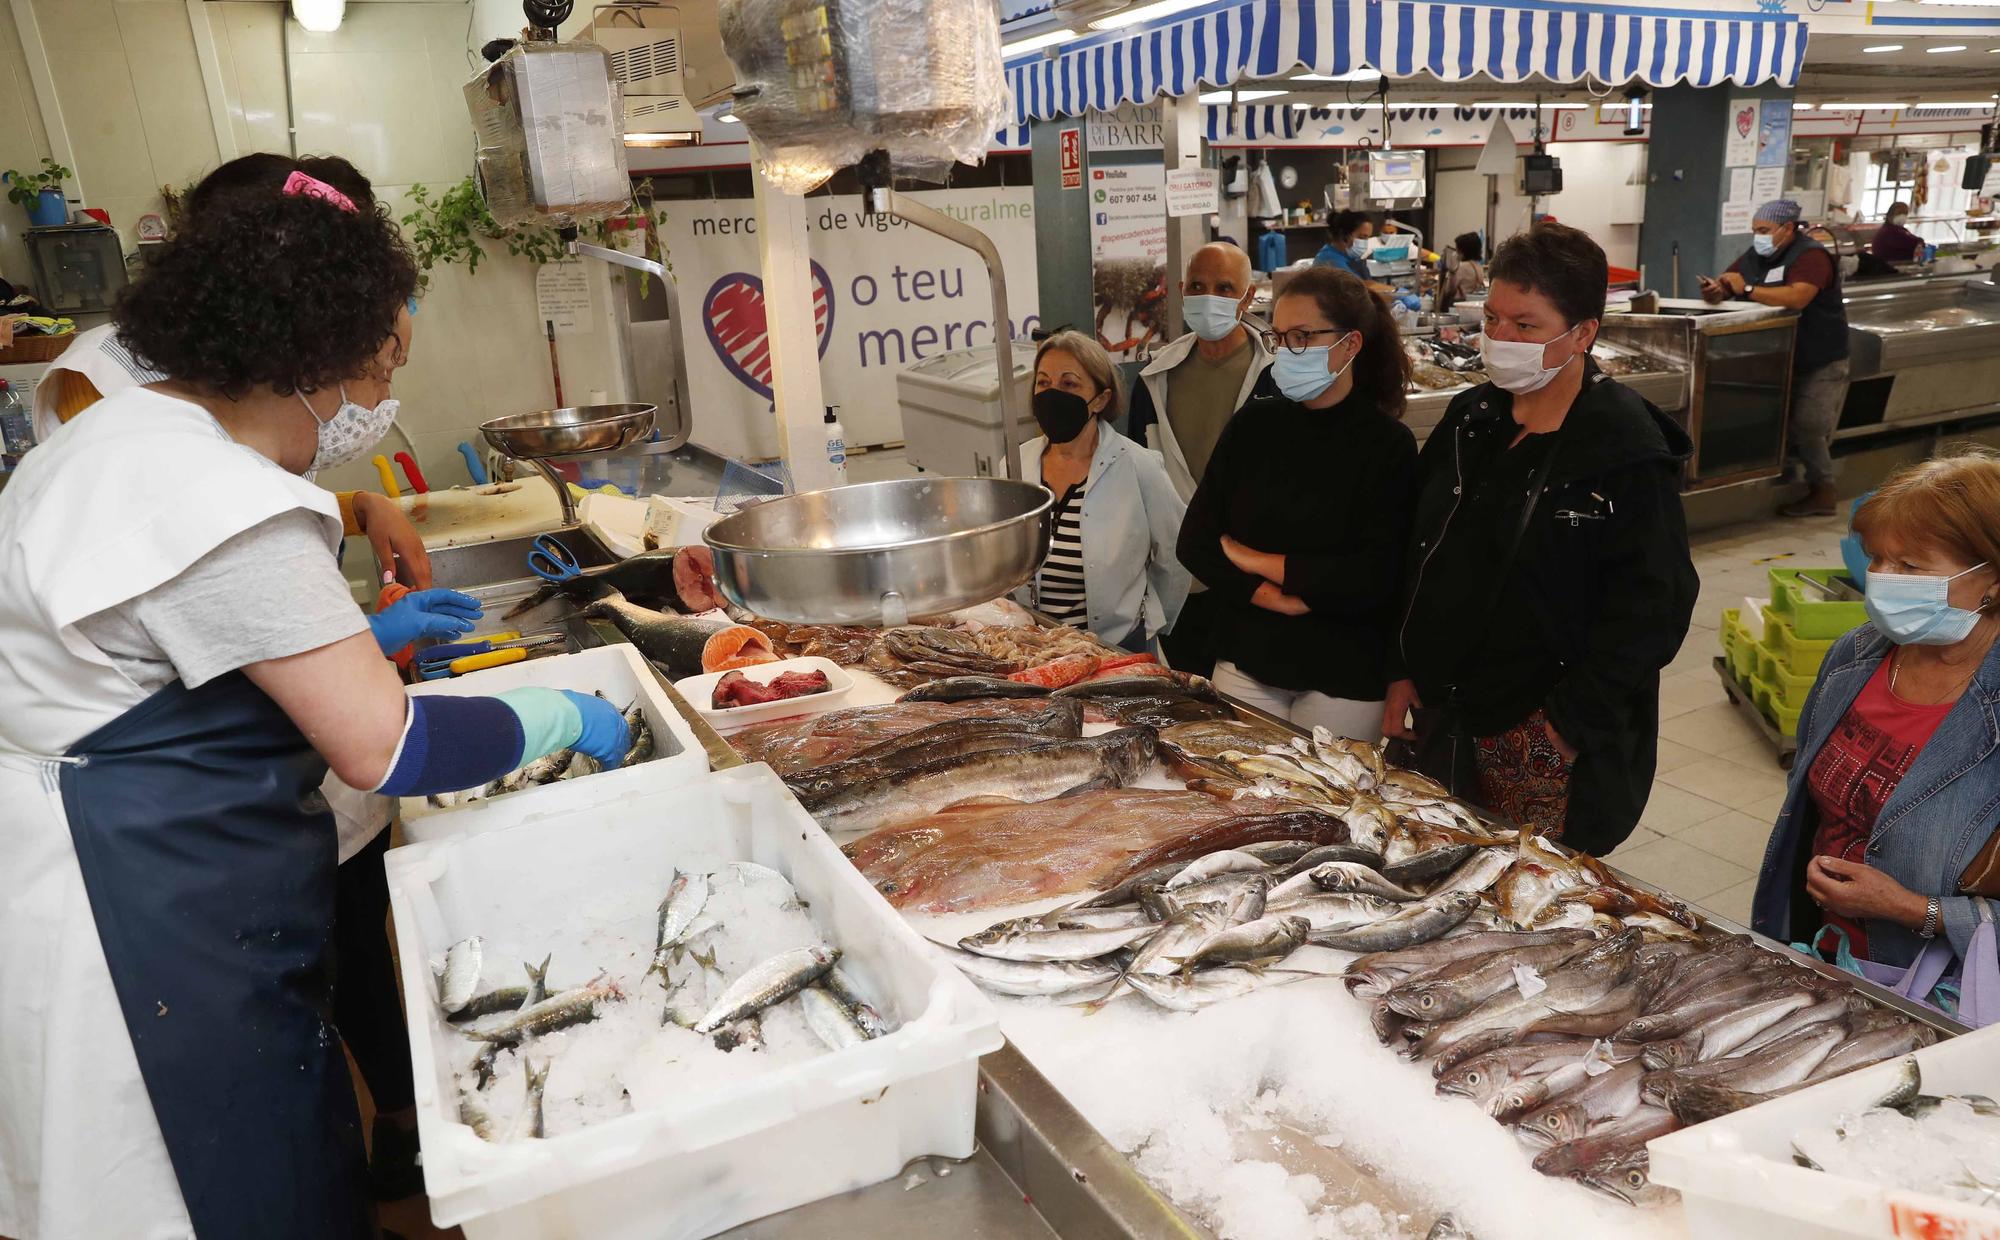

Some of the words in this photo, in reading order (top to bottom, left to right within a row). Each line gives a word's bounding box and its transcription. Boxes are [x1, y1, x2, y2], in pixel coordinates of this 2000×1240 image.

[1108, 124, 1164, 146] BARR
[1109, 195, 1124, 204] 607
[1126, 194, 1140, 203] 907
[1142, 194, 1157, 202] 454
[819, 208, 847, 231] de
[851, 275, 878, 306] o
[892, 265, 963, 302] teu
[827, 439, 845, 448] GEL
